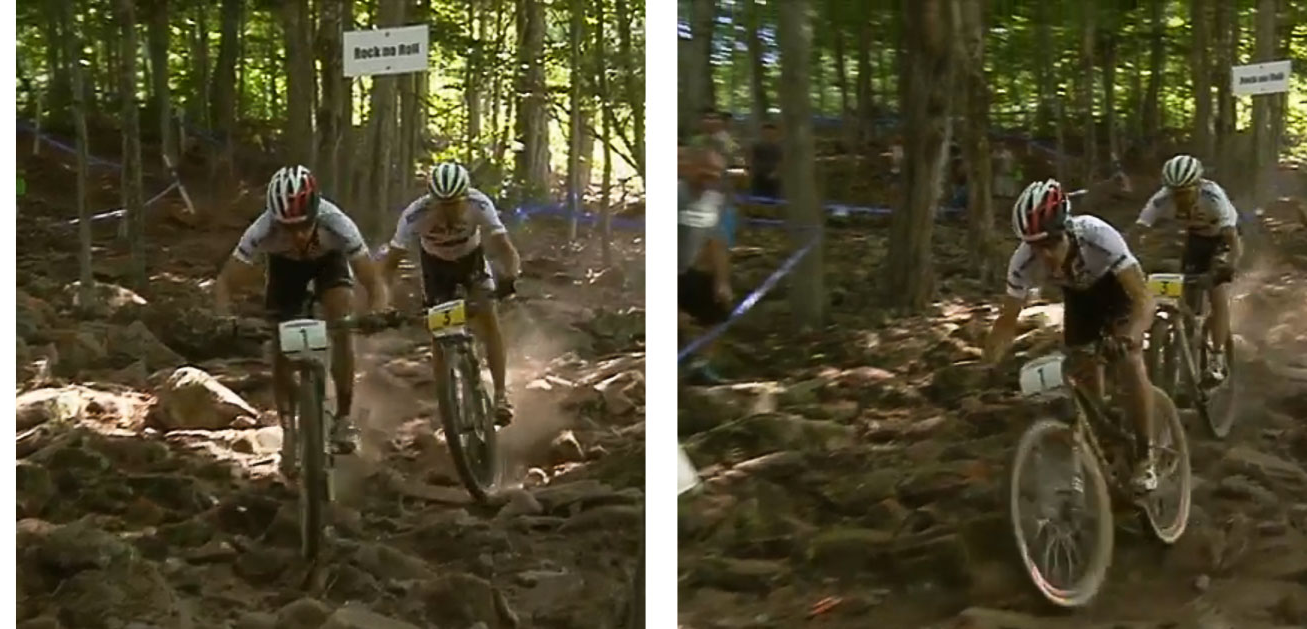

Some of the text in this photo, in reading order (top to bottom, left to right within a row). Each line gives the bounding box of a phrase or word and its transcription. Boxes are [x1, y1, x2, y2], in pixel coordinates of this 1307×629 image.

[354, 46, 381, 60] Rock
[299, 328, 308, 348] 1
[1037, 367, 1046, 386] 1
